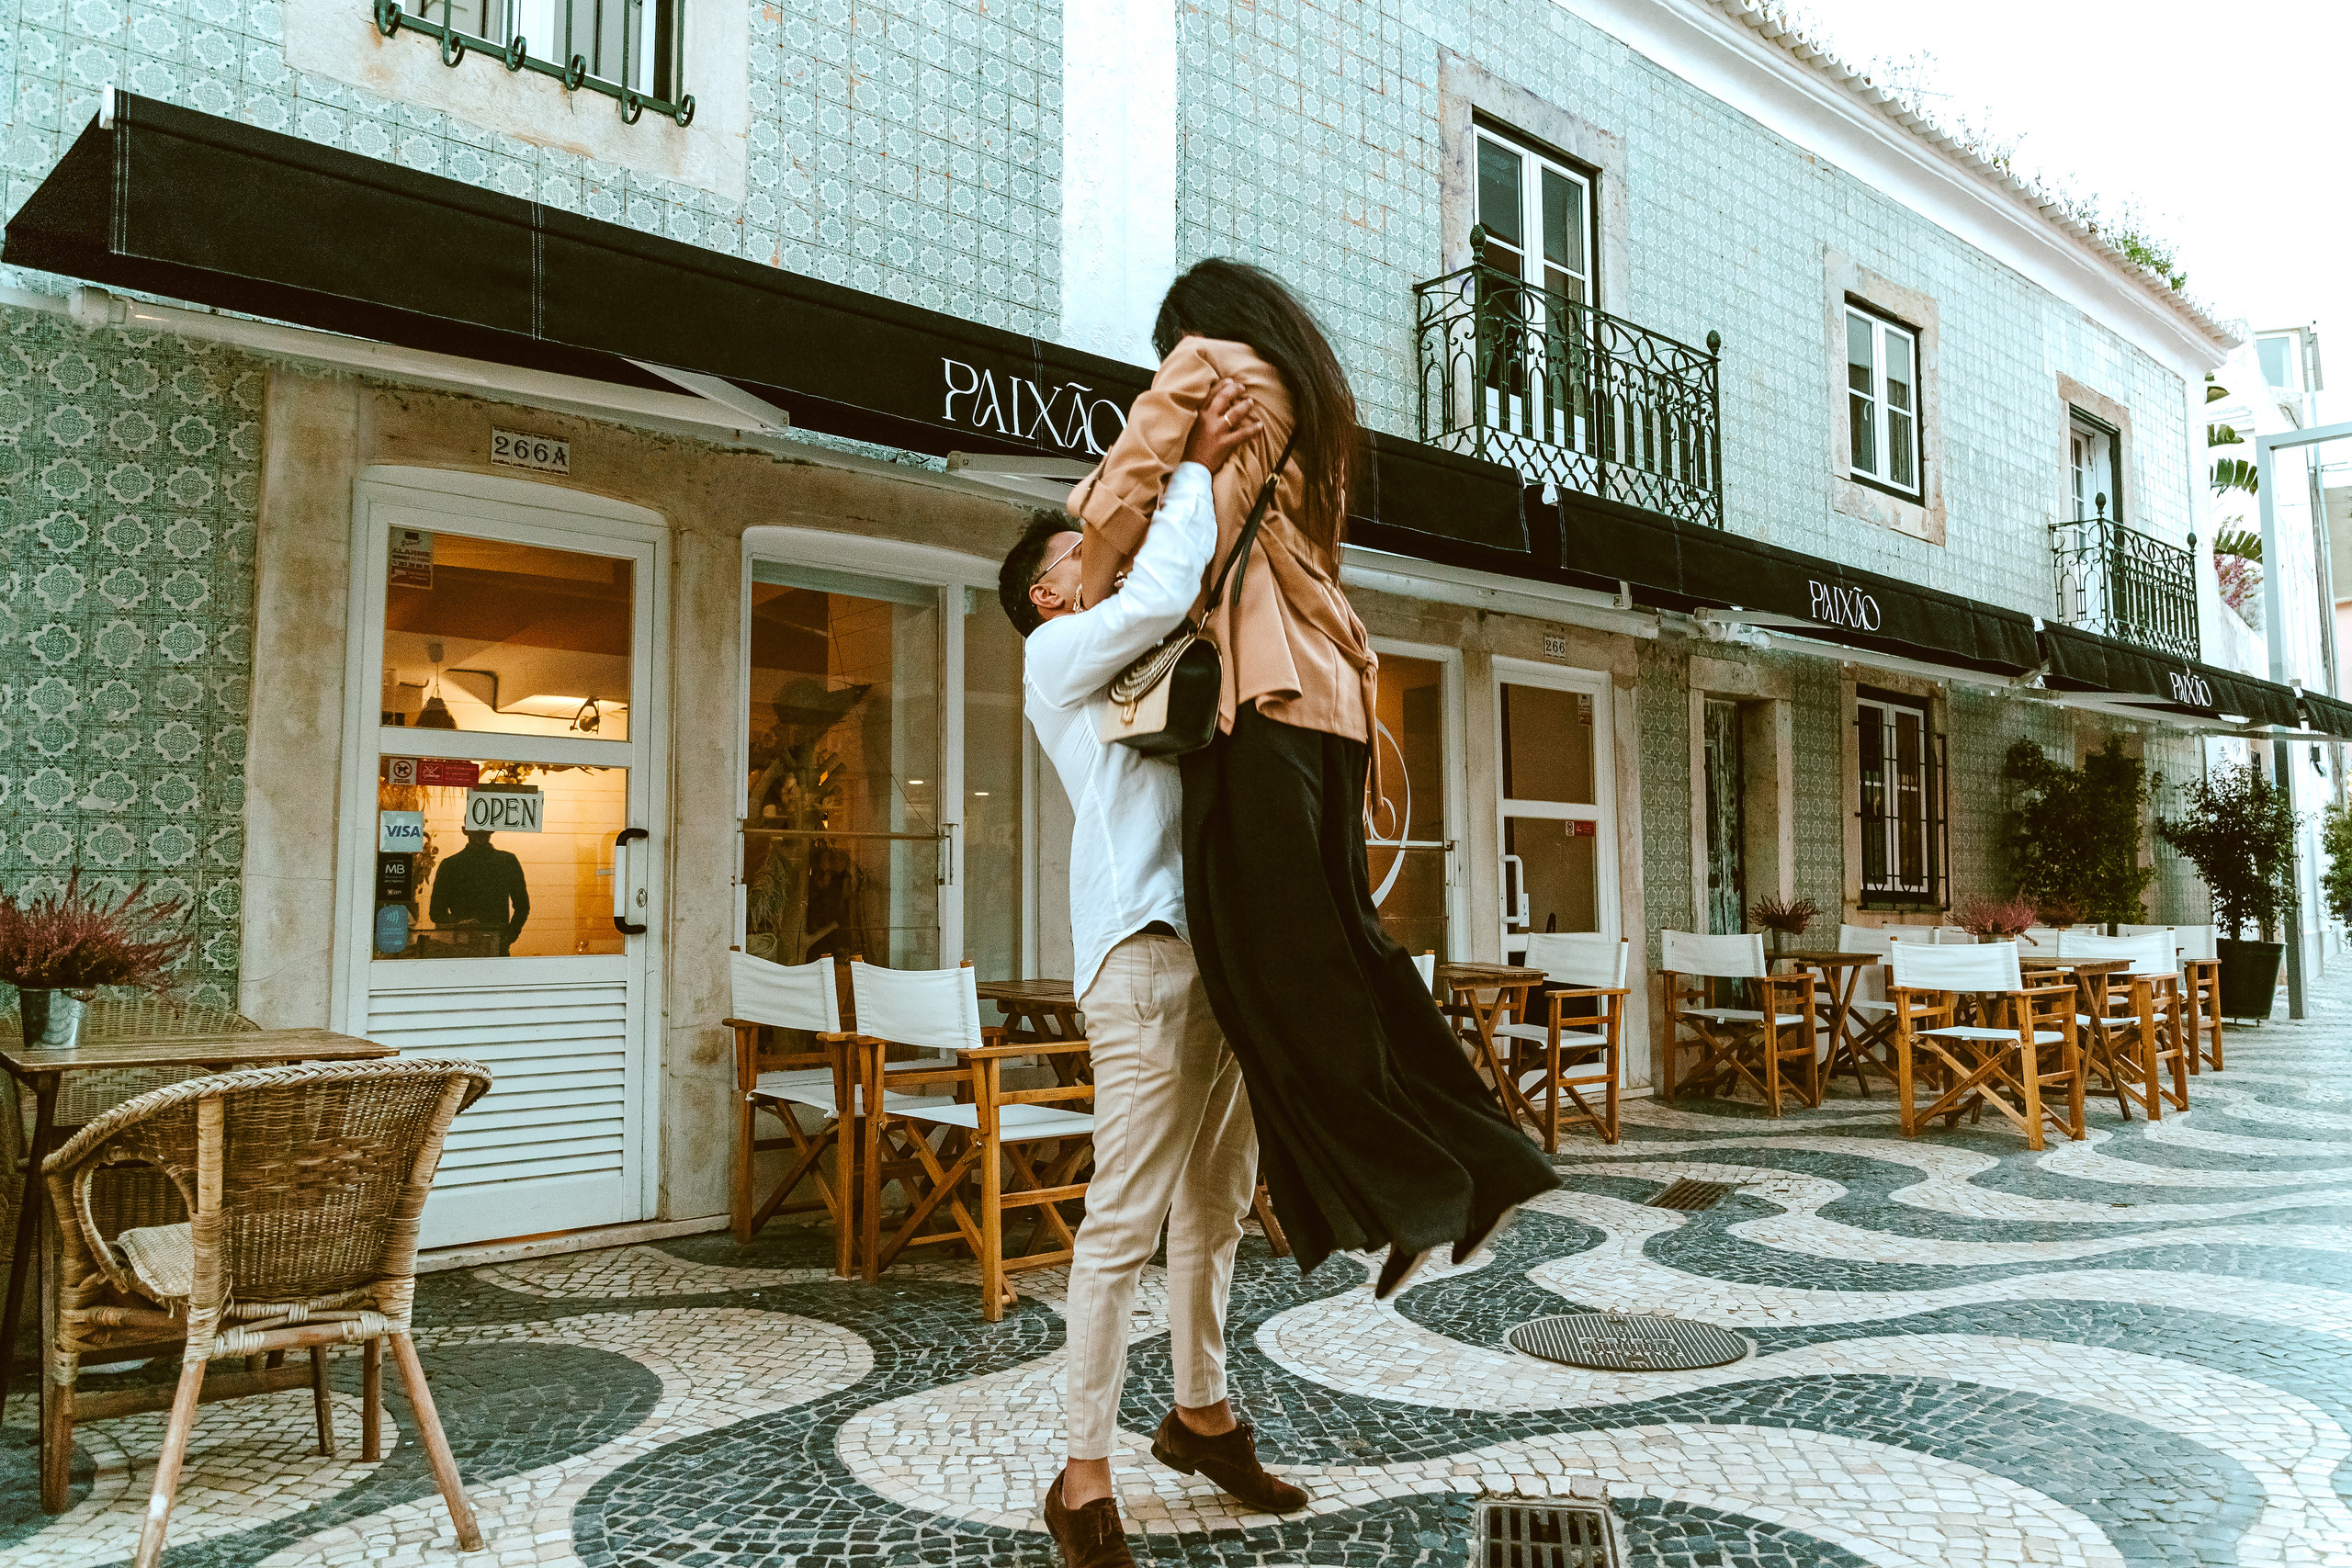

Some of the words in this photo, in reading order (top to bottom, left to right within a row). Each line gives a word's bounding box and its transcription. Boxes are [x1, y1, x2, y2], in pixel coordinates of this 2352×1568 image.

[941, 356, 1128, 457] PAIXÃO
[494, 435, 568, 467] 266A
[1808, 580, 1881, 631] PAIXÃO
[1545, 639, 1566, 654] 266
[2169, 671, 2212, 707] PAIXÃO
[471, 796, 538, 829] OPEN
[385, 825, 421, 838] VISA
[385, 863, 405, 874] MB
